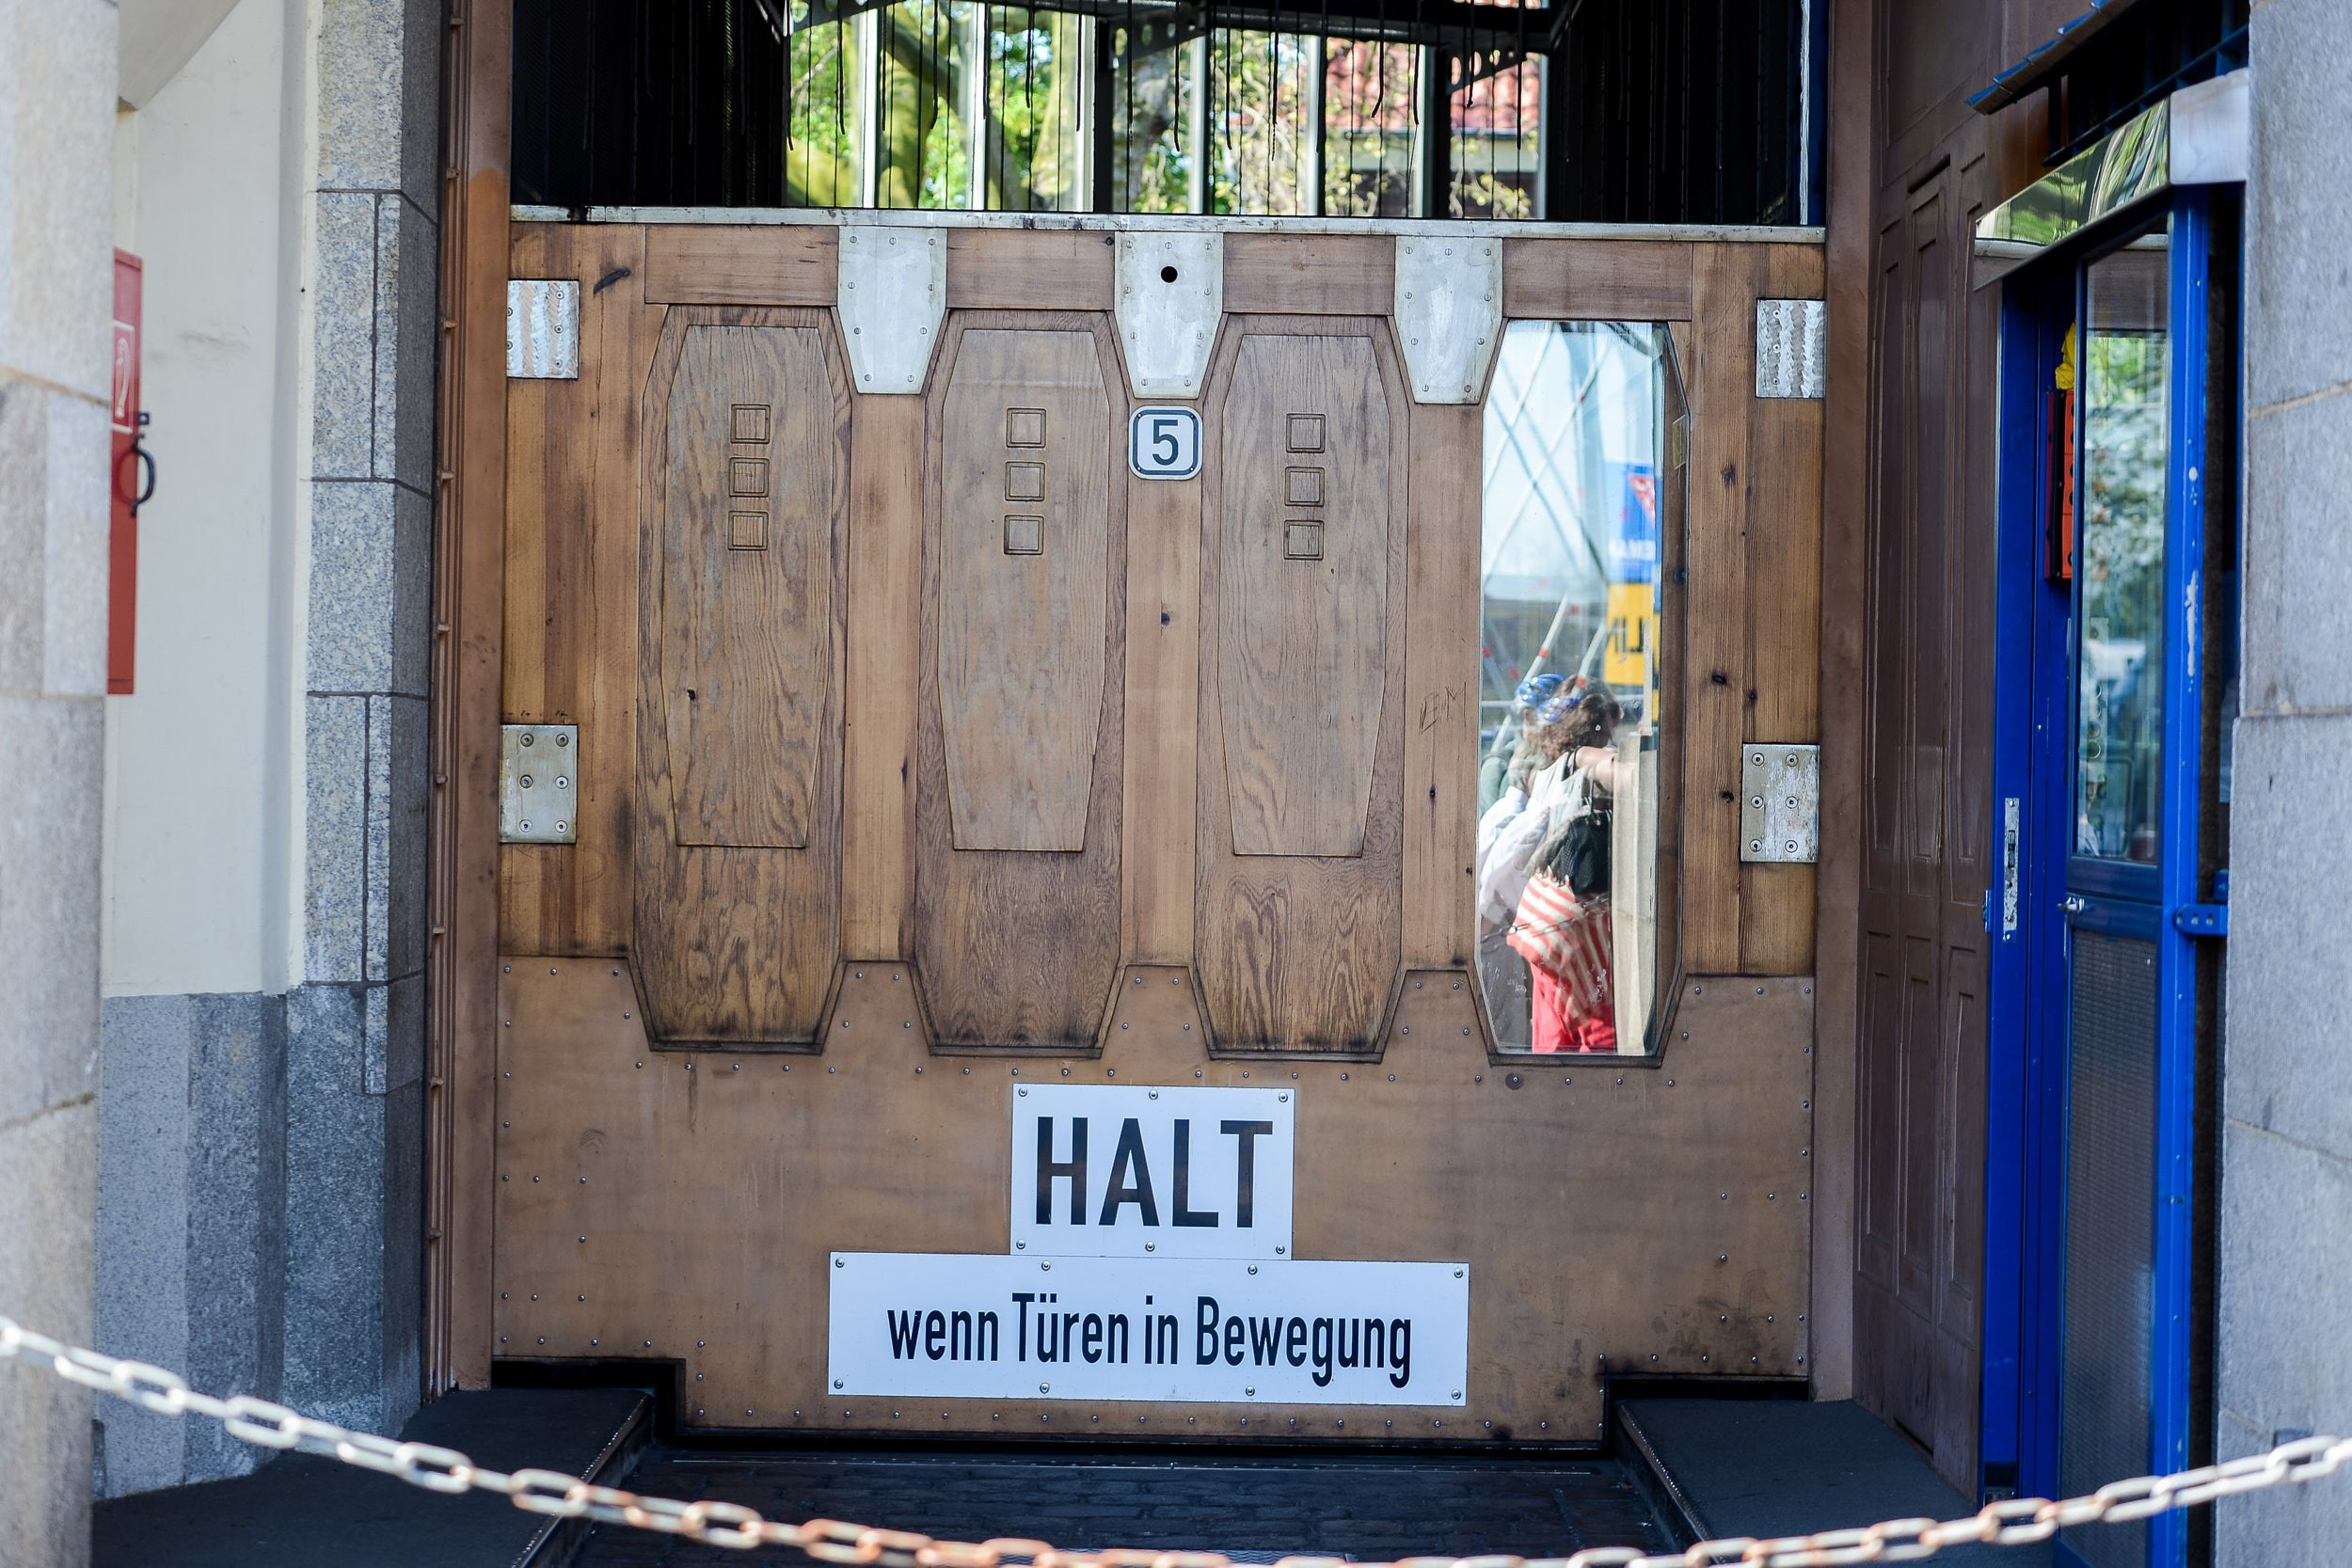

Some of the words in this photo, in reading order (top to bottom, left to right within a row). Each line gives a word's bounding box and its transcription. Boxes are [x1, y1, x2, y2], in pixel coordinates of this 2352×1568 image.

[1152, 419, 1179, 466] 5
[1036, 1116, 1273, 1228] HALT
[887, 1309, 999, 1362] wenn
[1011, 1292, 1129, 1364] Türen
[1144, 1294, 1179, 1365] in
[1196, 1295, 1411, 1388] Bewegung
